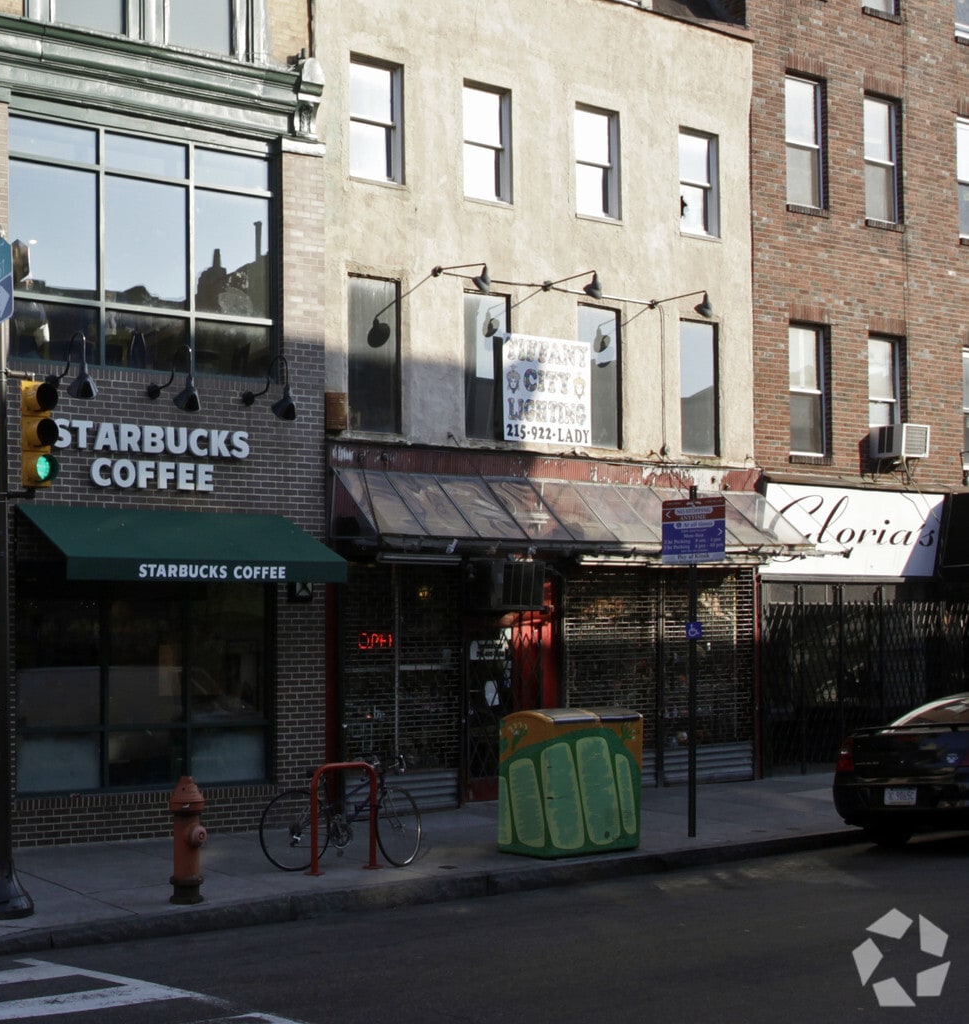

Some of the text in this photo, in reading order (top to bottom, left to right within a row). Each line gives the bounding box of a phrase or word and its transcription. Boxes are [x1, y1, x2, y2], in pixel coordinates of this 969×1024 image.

[507, 338, 589, 368] TIFFANY
[523, 368, 572, 395] CITY
[507, 397, 587, 426] LIGHTING
[54, 418, 250, 459] STARBUCKS
[90, 457, 215, 492] COFFEE
[138, 564, 286, 579] STARBUCKS COFFEE
